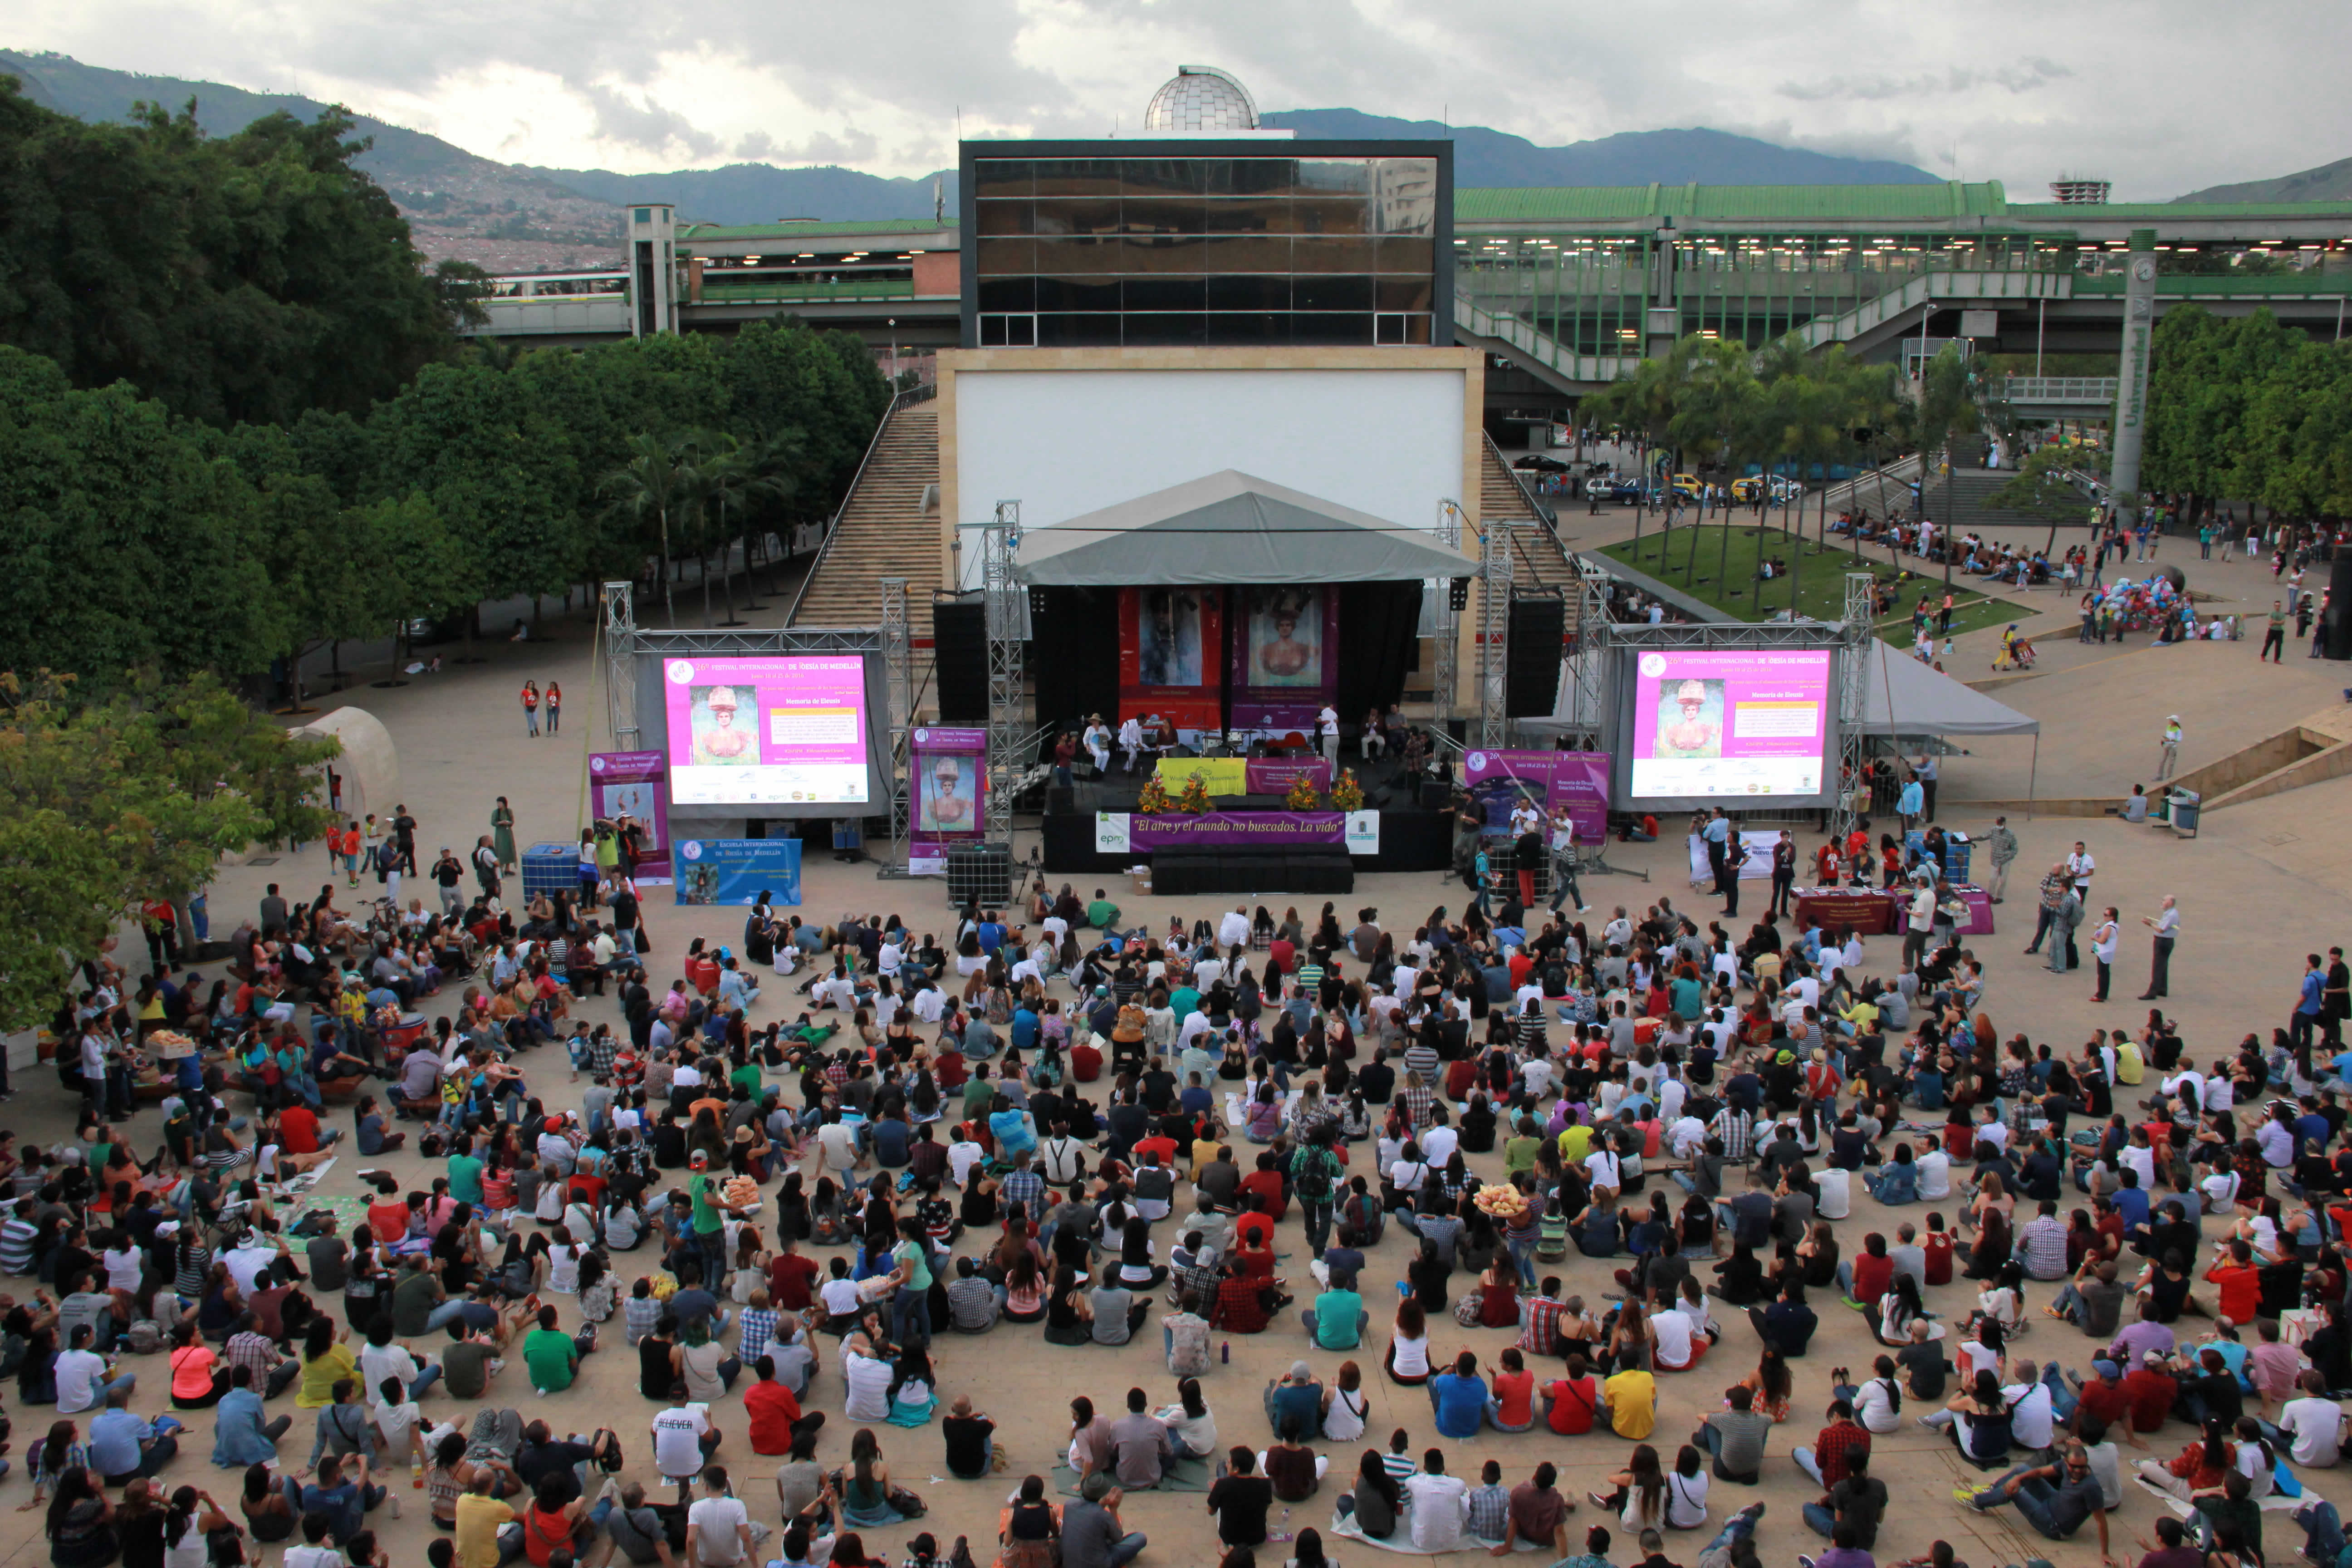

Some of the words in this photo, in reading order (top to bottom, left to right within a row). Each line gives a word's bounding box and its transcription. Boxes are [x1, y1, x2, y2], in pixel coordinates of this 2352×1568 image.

[2125, 327, 2146, 428] Universidad
[1151, 821, 1171, 831] aire
[1173, 823, 1180, 834] y
[1183, 820, 1192, 831] el
[1194, 820, 1230, 831] mundo
[1248, 820, 1297, 832] buscados.
[1300, 820, 1313, 832] La
[1101, 835, 1124, 845] epm
[658, 1418, 693, 1430] BELIEVER
